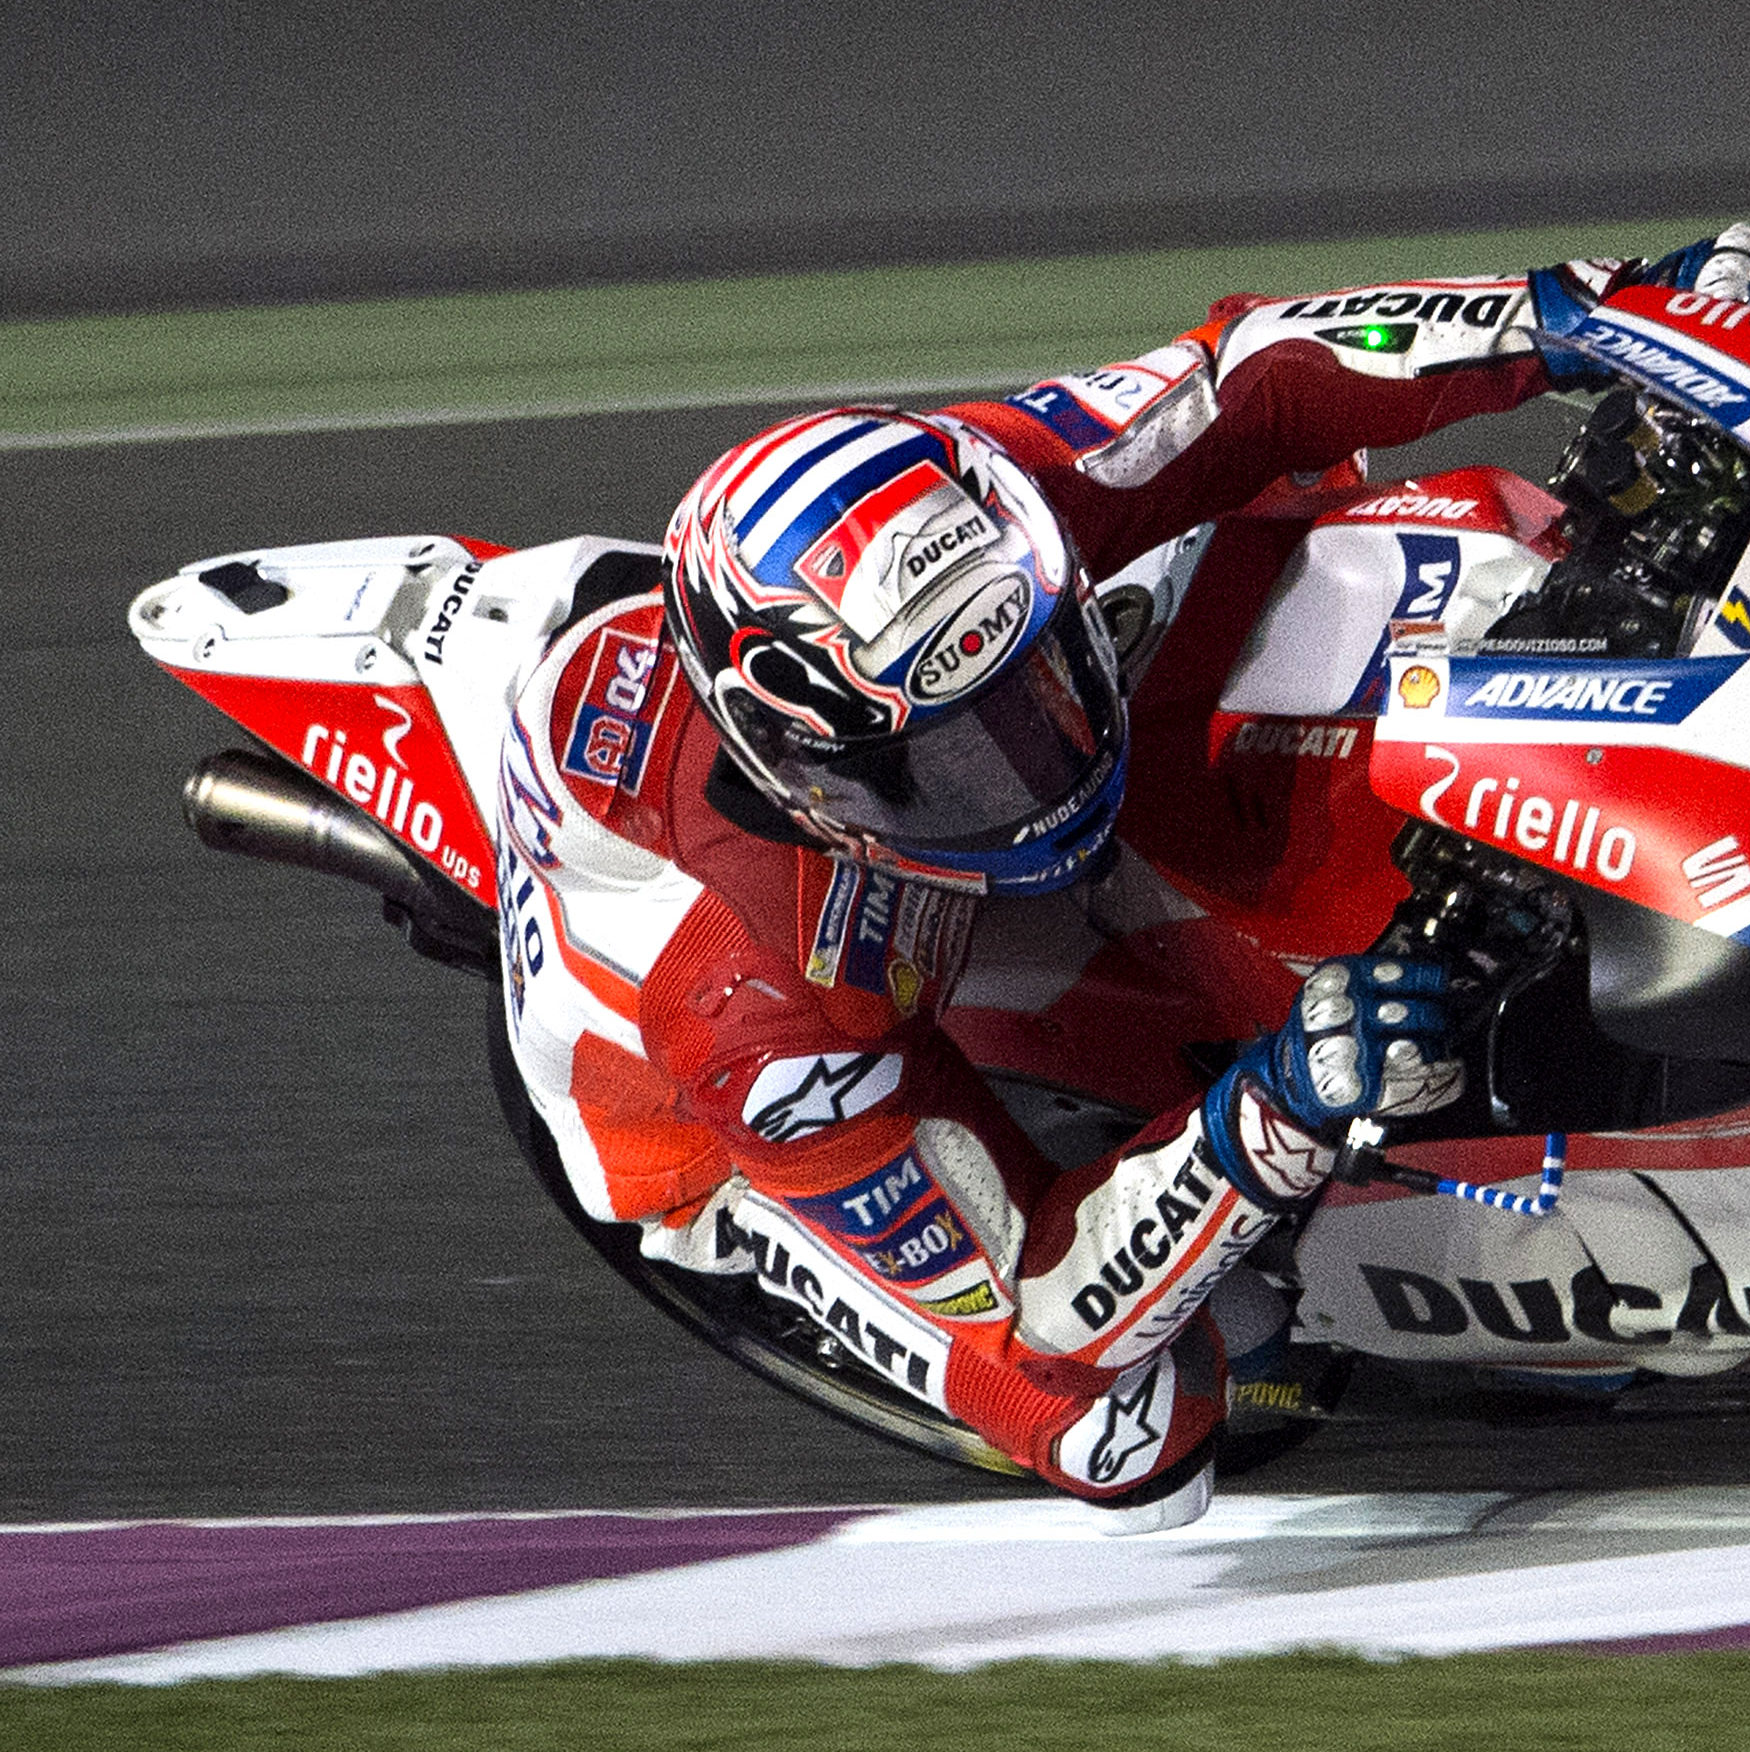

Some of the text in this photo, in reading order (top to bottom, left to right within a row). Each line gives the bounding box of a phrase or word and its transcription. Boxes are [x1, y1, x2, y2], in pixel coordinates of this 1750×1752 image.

[1280, 292, 1513, 328] DUCATI
[1583, 325, 1748, 408] ADVANCE
[1346, 495, 1479, 519] DUCATI
[907, 516, 986, 578] DUCATI
[424, 562, 483, 666] DUCATI
[1465, 674, 1675, 714] ADVANCE
[1235, 722, 1359, 759] DUCATI
[302, 723, 443, 853] riello
[441, 845, 482, 889] ups
[1465, 776, 1637, 883] riello
[858, 871, 896, 943] TIM
[841, 1156, 922, 1227] TIM
[1071, 1135, 1226, 1332] DUCATI
